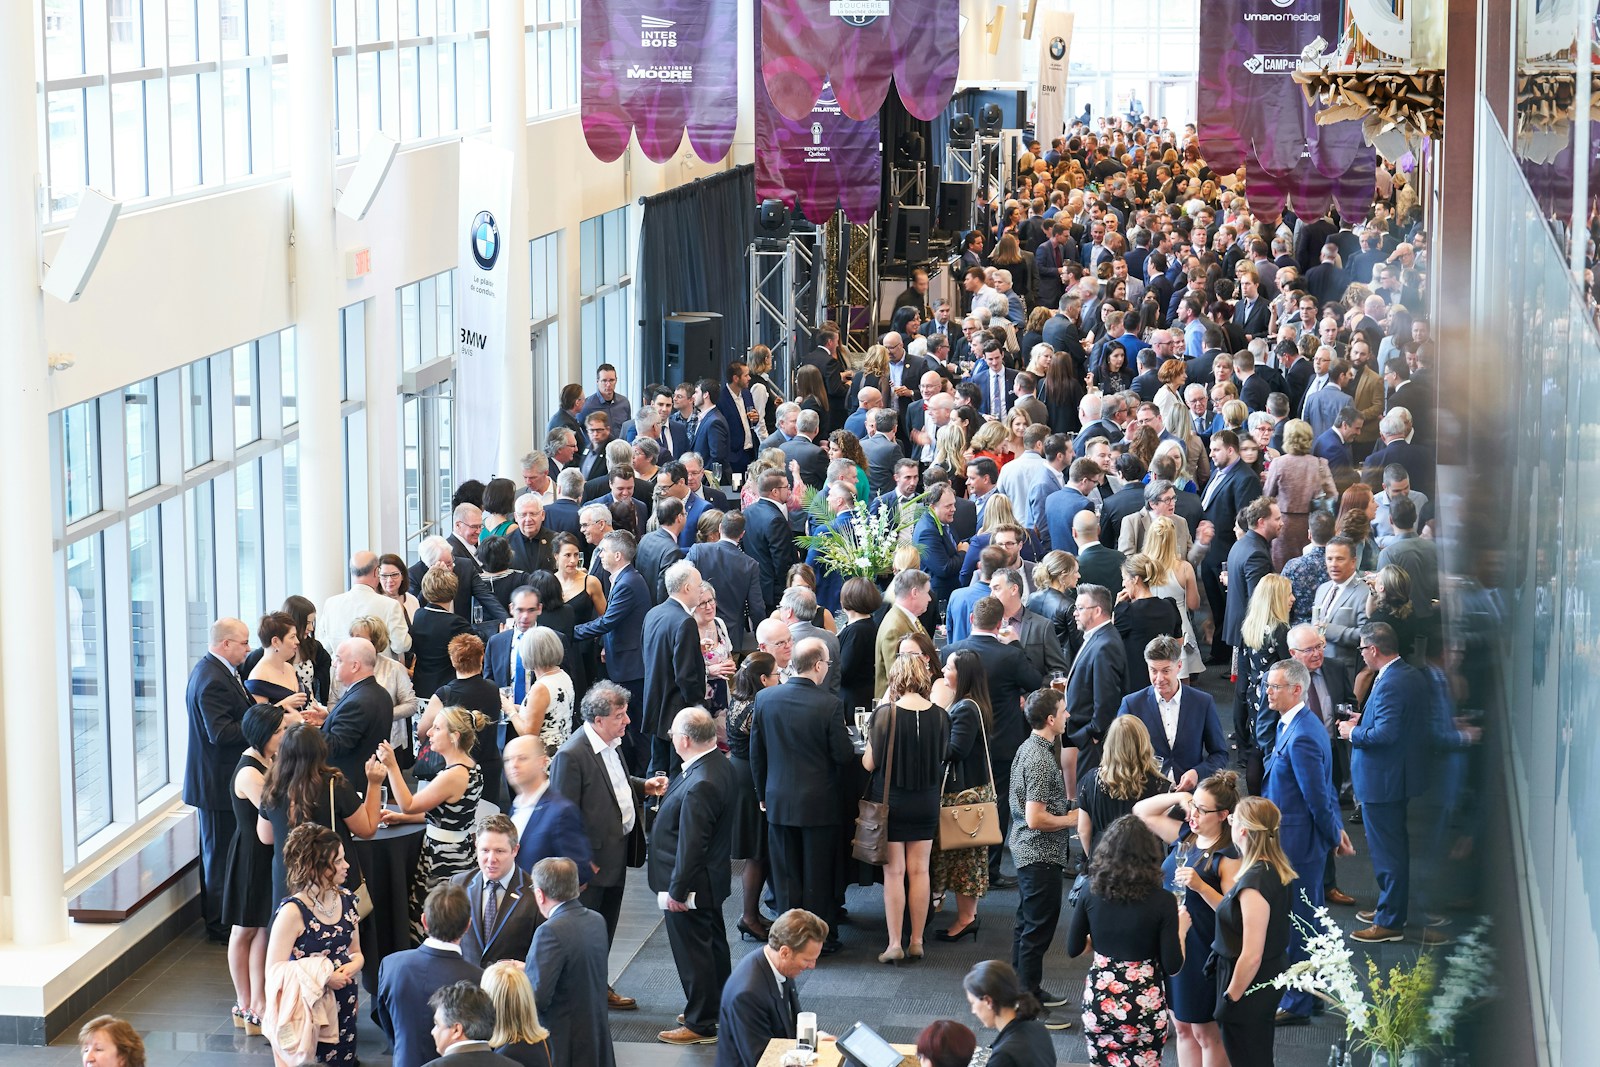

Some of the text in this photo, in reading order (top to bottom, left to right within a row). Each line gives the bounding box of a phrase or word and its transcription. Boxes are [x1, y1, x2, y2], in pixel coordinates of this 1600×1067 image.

[641, 31, 677, 39] INTER
[641, 39, 678, 48] BOIS
[1264, 59, 1289, 70] CAMP
[627, 68, 693, 79] MOORE
[1042, 84, 1057, 93] BMW
[461, 327, 487, 350] BMW
[461, 345, 473, 357] évis
